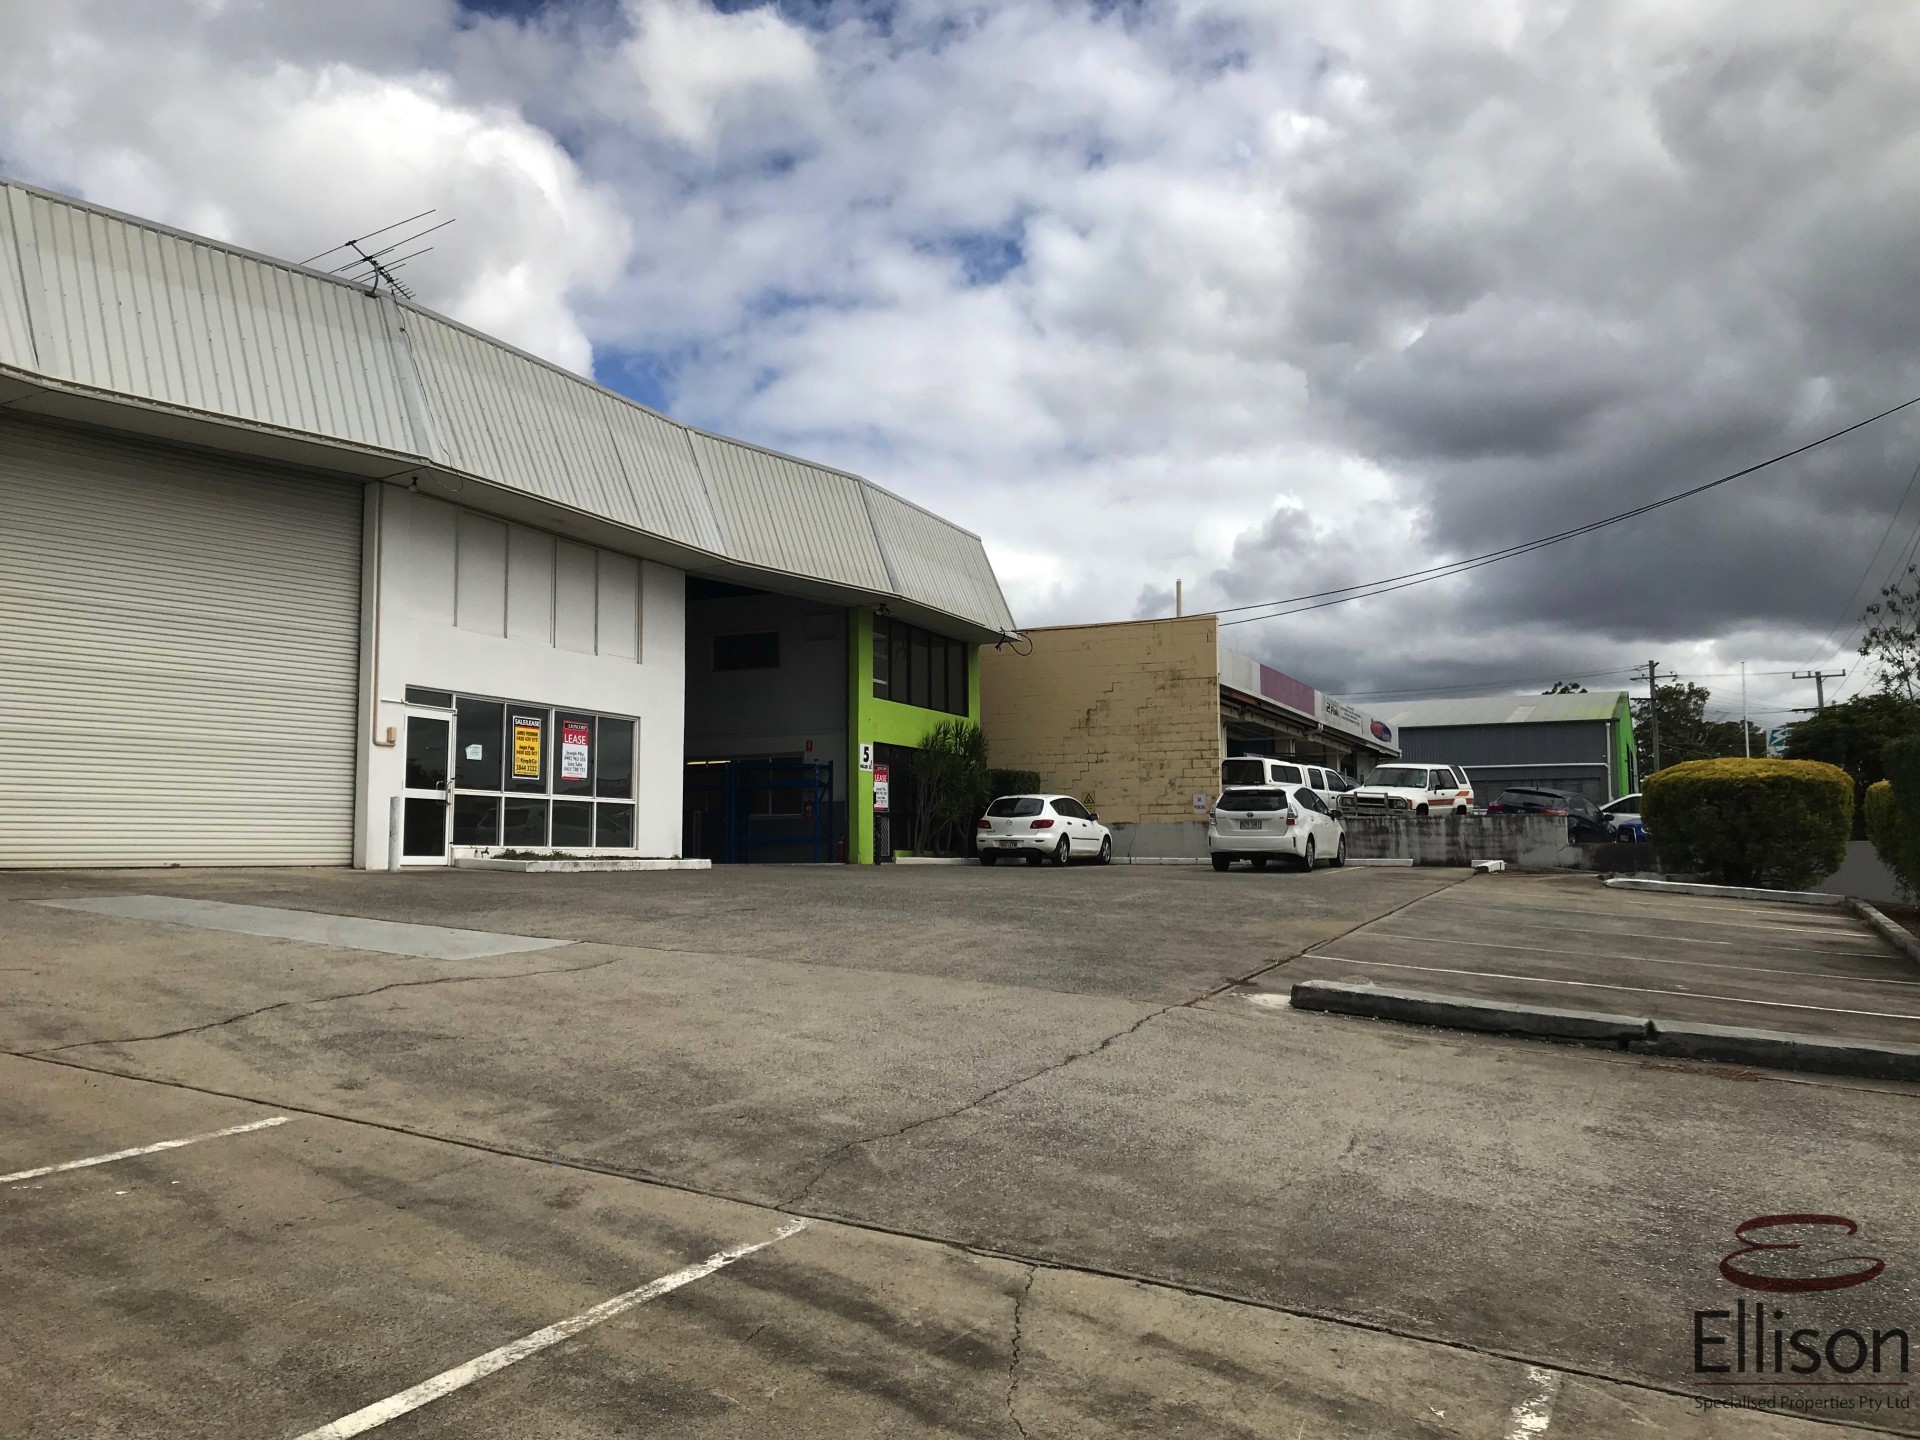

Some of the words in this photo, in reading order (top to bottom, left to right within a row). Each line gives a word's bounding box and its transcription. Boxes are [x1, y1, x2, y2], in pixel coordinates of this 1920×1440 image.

[564, 733, 586, 745] LEASE
[863, 746, 869, 762] 5
[874, 774, 887, 782] LEASE
